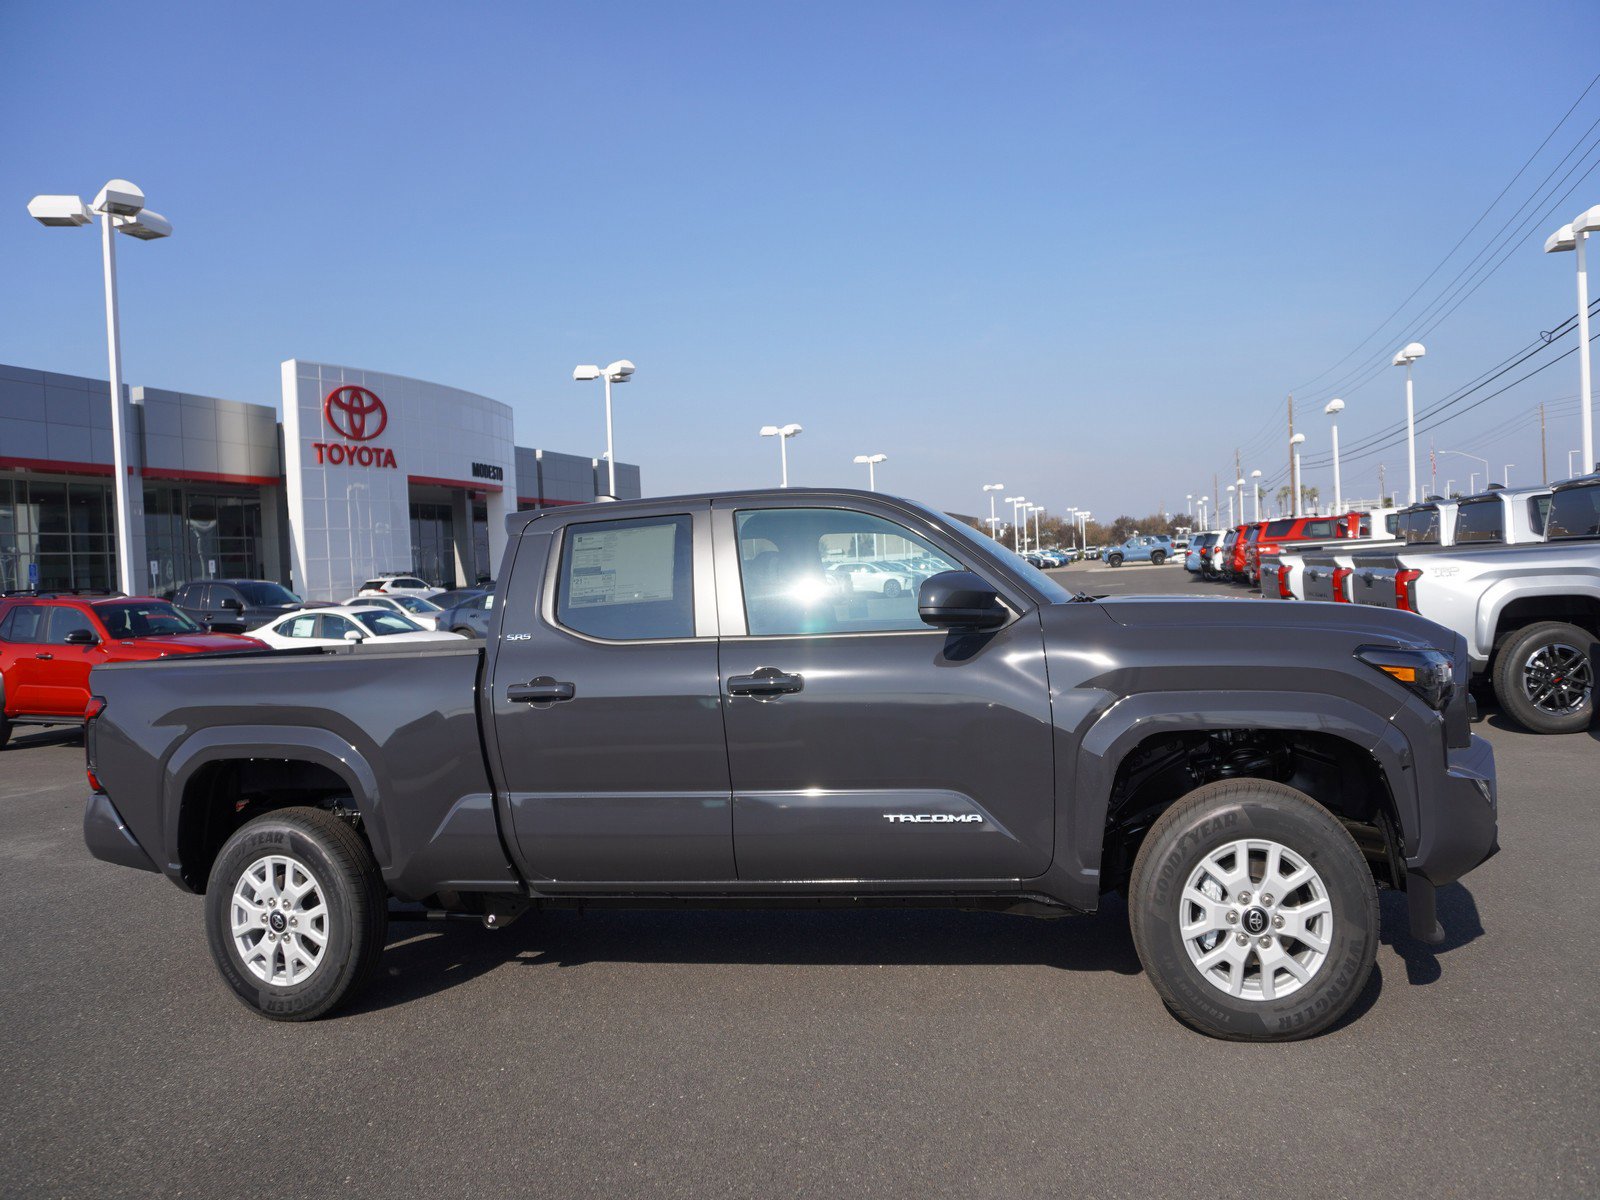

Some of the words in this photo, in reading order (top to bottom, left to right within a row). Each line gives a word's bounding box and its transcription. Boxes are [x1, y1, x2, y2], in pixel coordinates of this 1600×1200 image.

[313, 443, 398, 469] TOYOTA
[471, 462, 504, 482] MODESTO
[883, 814, 983, 823] TACOMA
[1155, 811, 1238, 906] GOODYEAR
